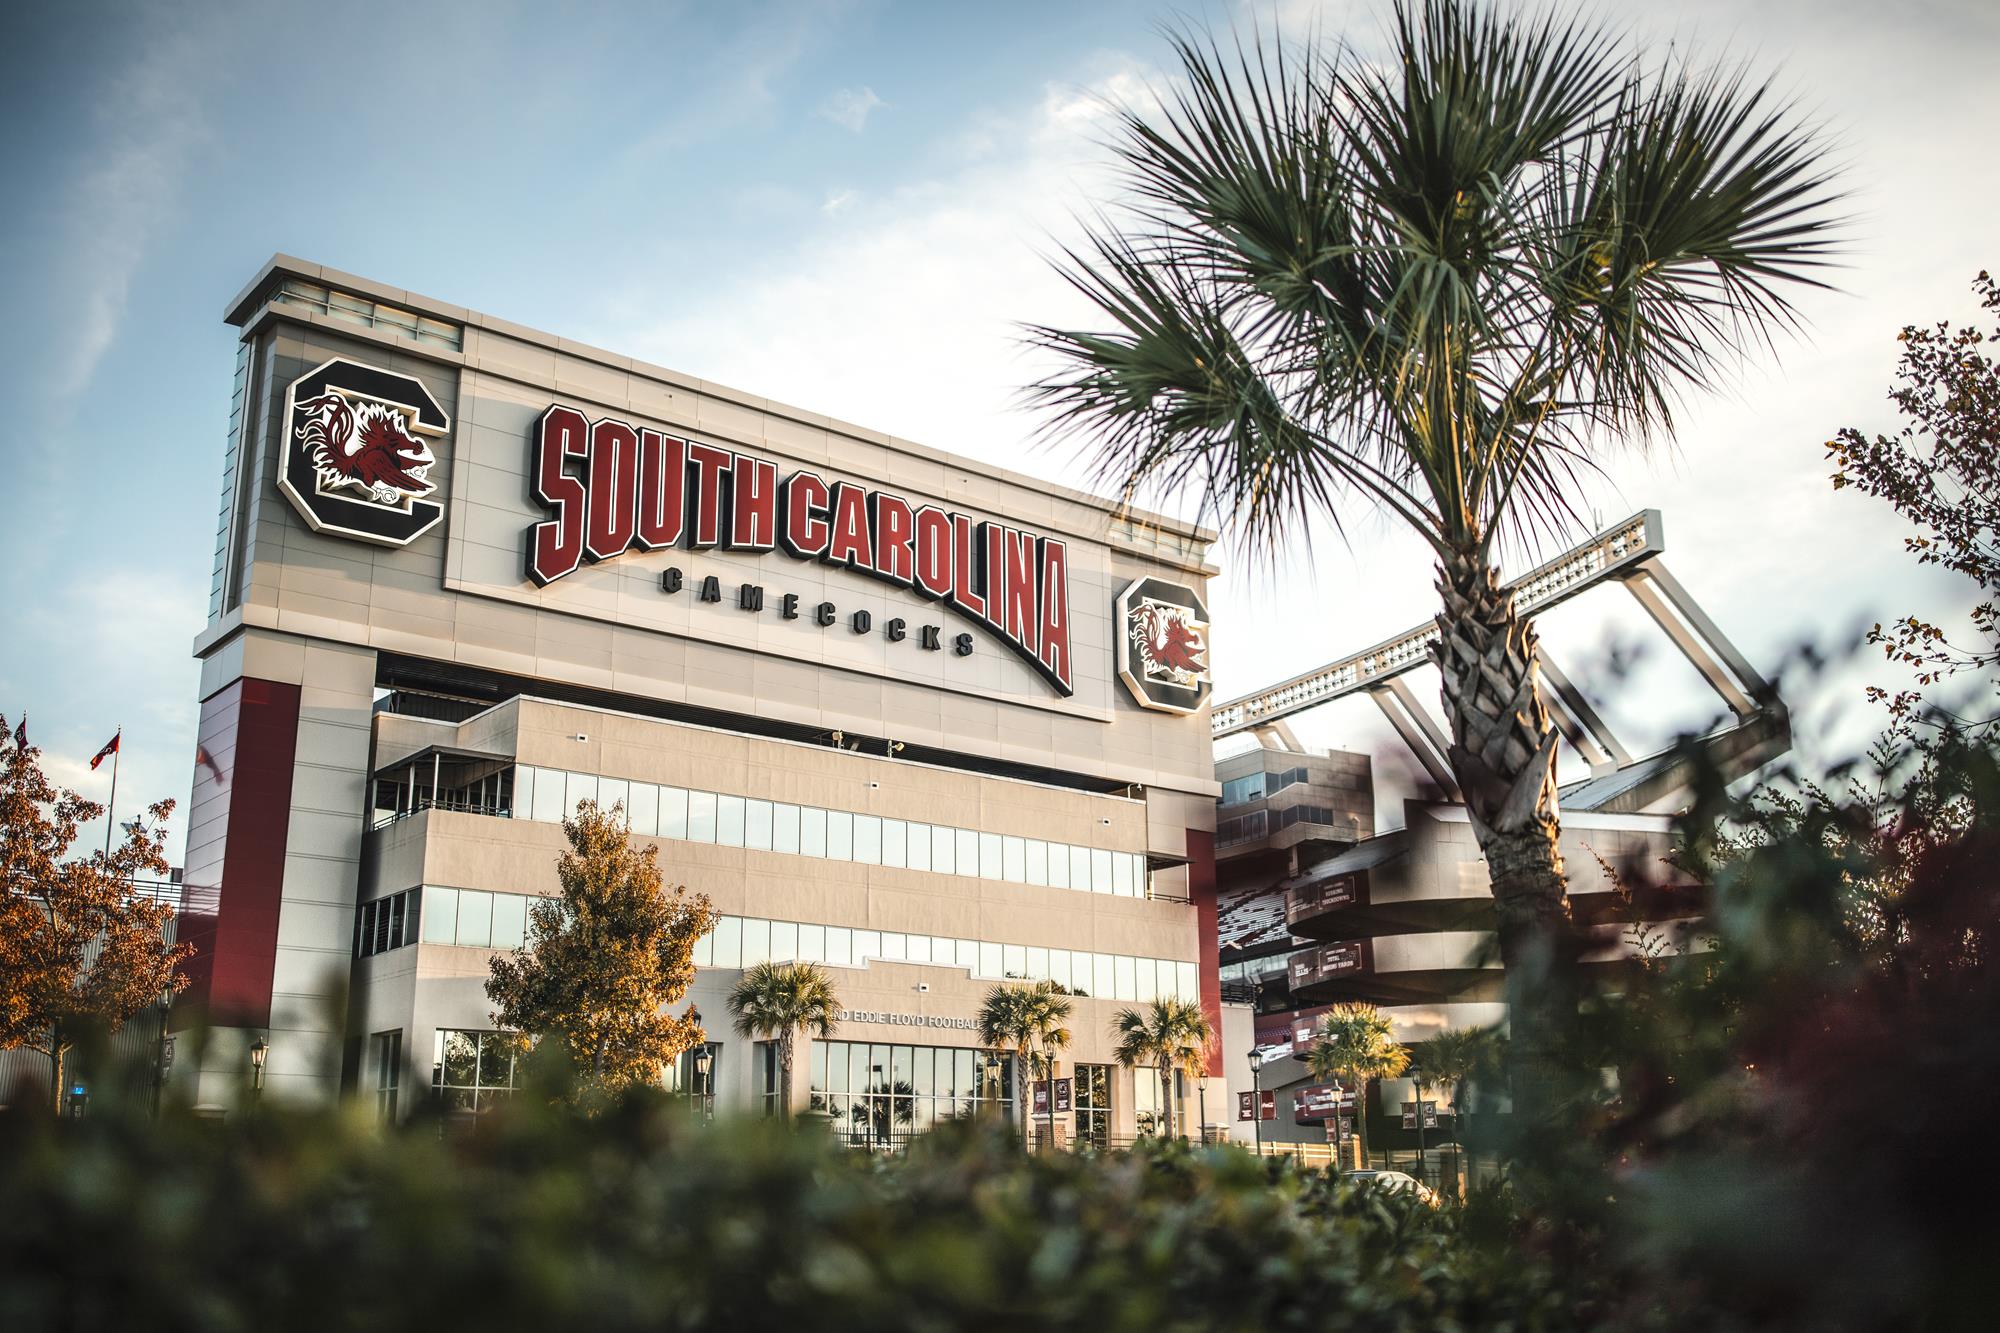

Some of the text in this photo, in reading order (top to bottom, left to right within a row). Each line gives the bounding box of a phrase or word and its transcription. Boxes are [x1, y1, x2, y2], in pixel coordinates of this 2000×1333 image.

[525, 403, 1073, 697] SOUTH CAROLINA
[662, 567, 973, 656] GAMECOCKS
[832, 1009, 849, 1021] ND
[853, 1010, 886, 1024] EDDIE
[889, 1013, 924, 1026] FLOYD
